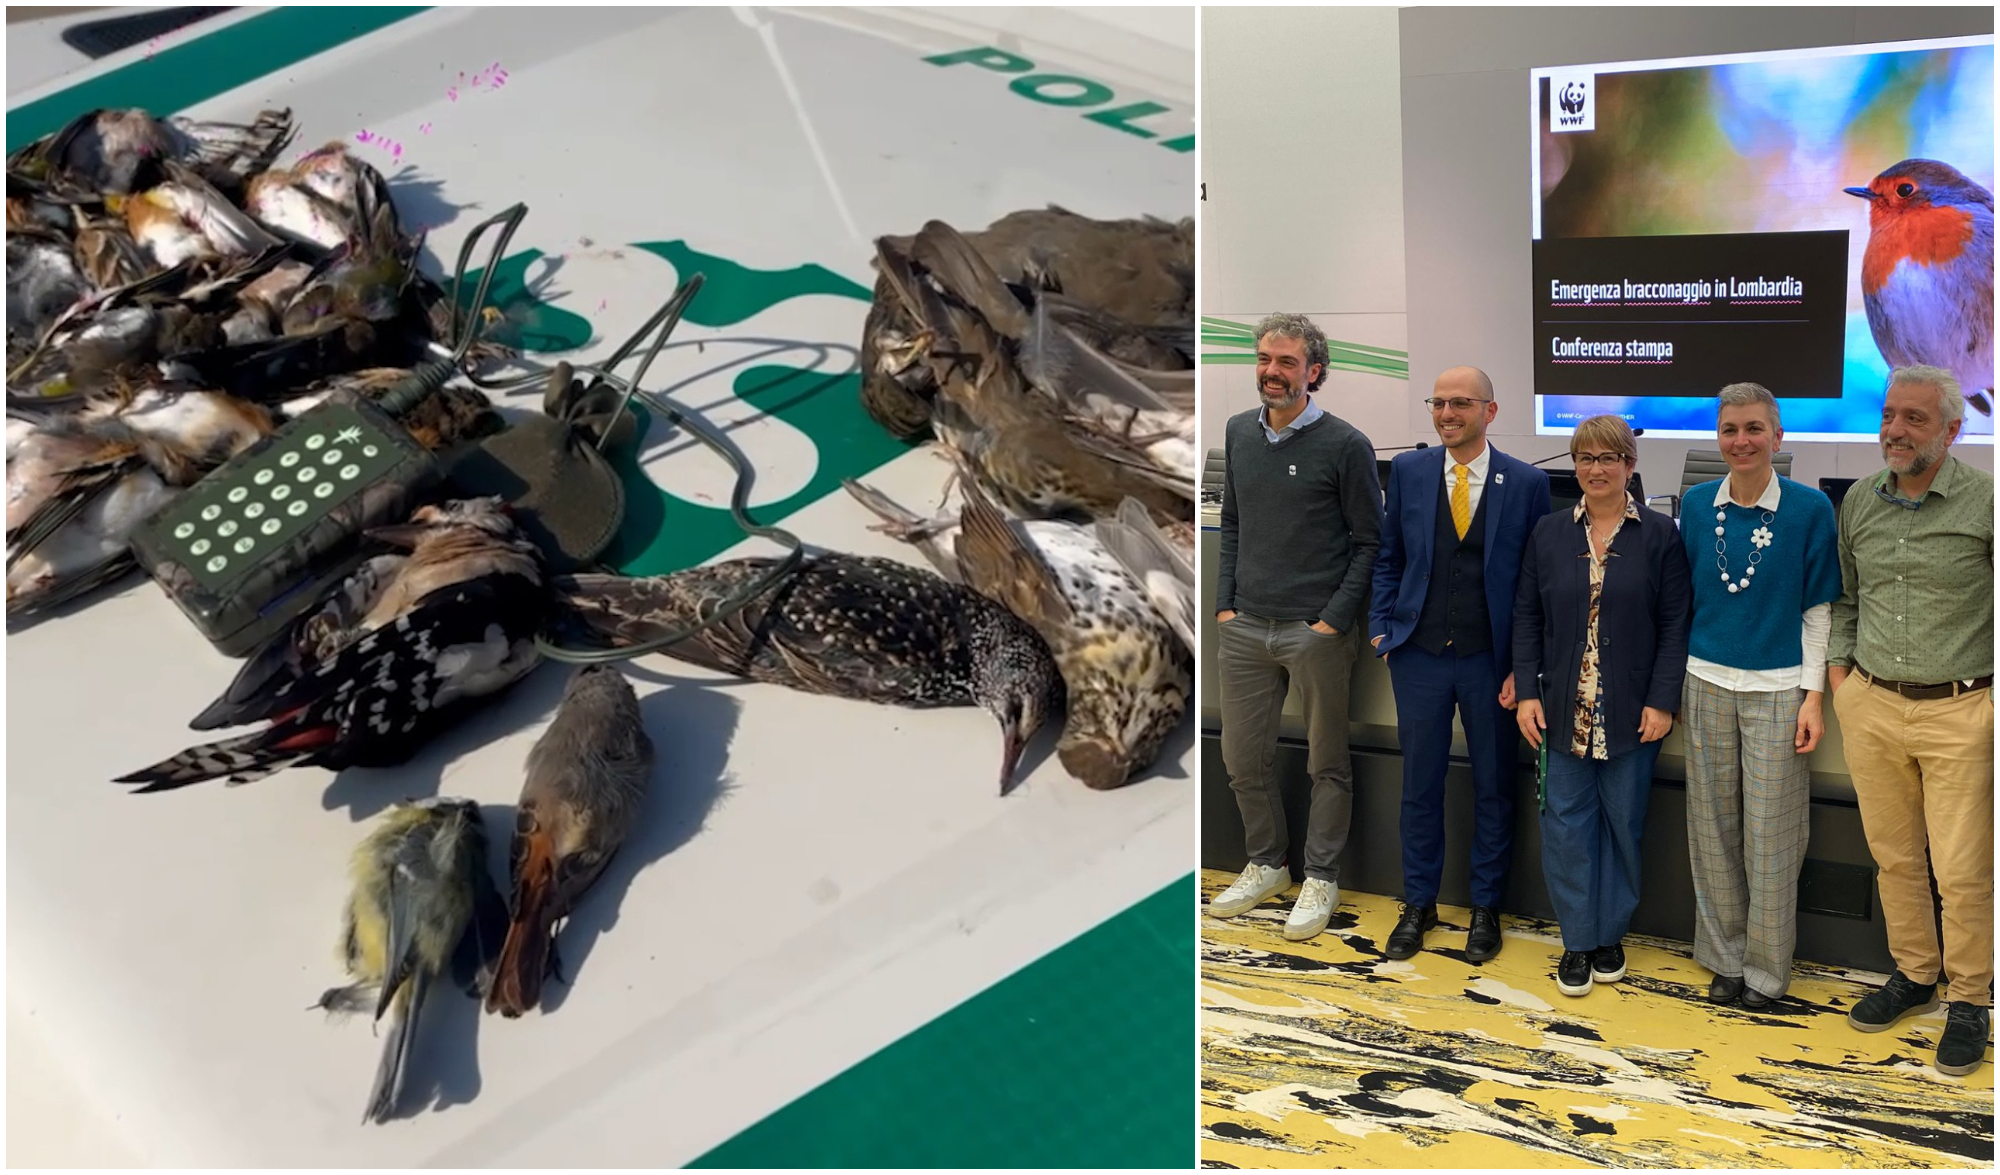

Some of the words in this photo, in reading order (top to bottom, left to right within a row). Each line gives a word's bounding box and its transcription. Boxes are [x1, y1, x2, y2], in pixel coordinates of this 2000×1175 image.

[1560, 116, 1584, 125] WWF
[1551, 279, 1620, 303] Emergenza
[1624, 278, 1711, 302] bracconaggio
[1714, 278, 1727, 298] in
[1730, 275, 1802, 297] Lombardia
[1552, 336, 1622, 357] Conferenza
[1625, 339, 1673, 361] stampa
